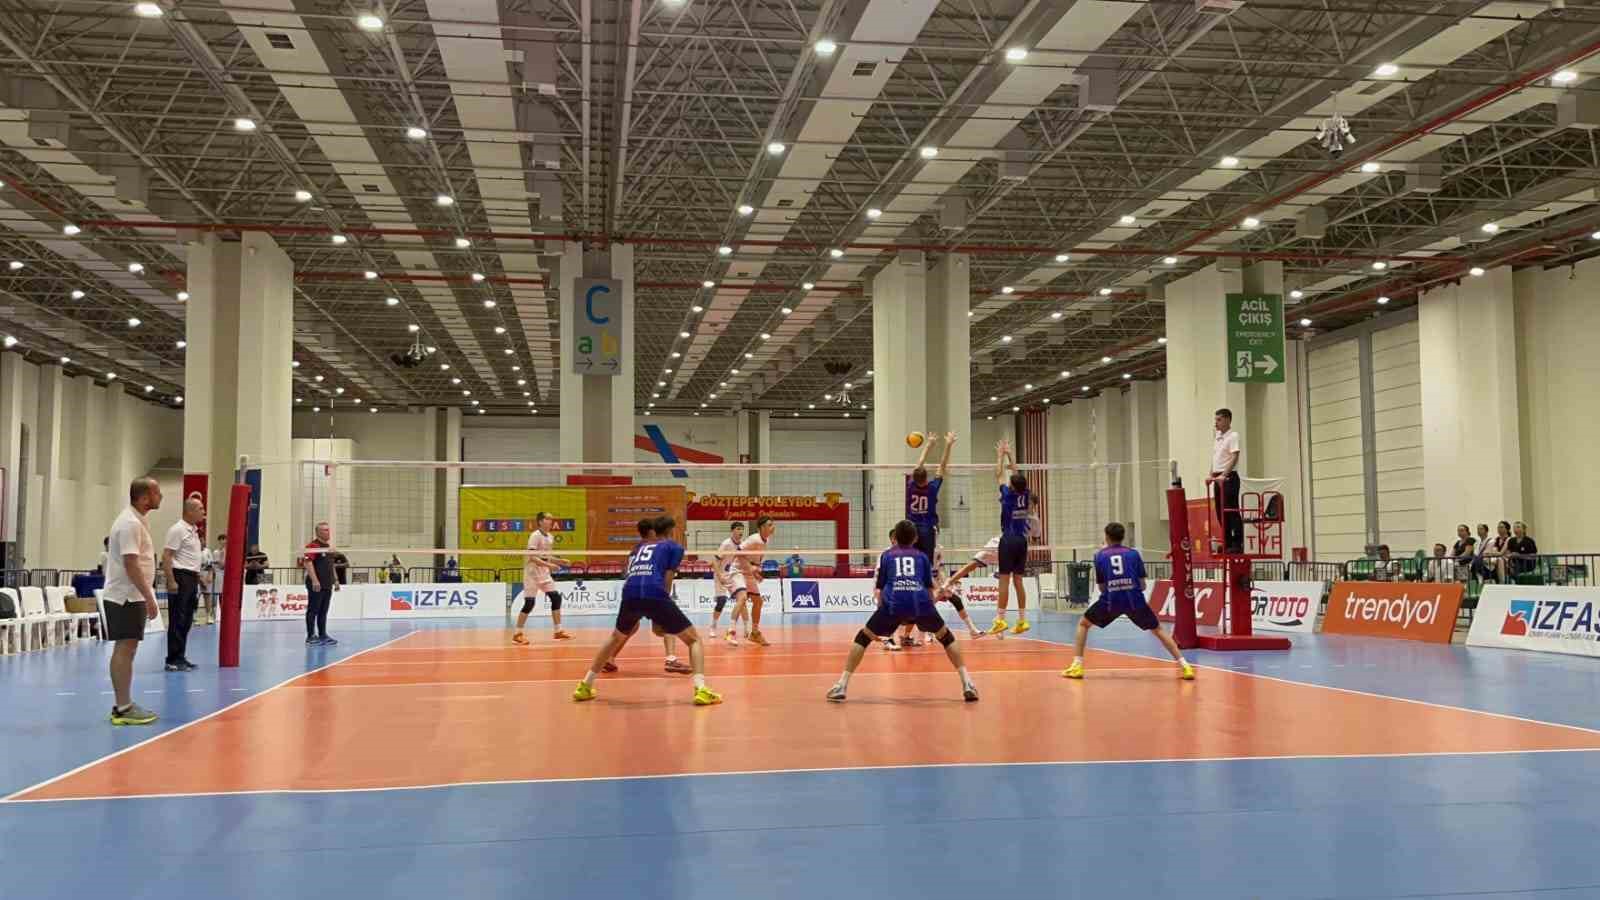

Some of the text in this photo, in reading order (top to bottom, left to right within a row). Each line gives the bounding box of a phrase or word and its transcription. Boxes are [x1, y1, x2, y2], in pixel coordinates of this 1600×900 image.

[586, 285, 610, 324] C
[1241, 298, 1270, 312] ACİL
[1238, 313, 1273, 326] ÇIKIŞ
[577, 328, 618, 355] a b
[758, 496, 818, 507] VOLEYBOL
[911, 494, 929, 512] 20
[474, 520, 573, 532] FESTIAL
[635, 544, 657, 562] 15
[895, 556, 915, 577] 18
[1110, 555, 1124, 575] 9
[595, 591, 617, 603] SU
[825, 594, 849, 606] AXA
[1344, 591, 1441, 629] trendyol
